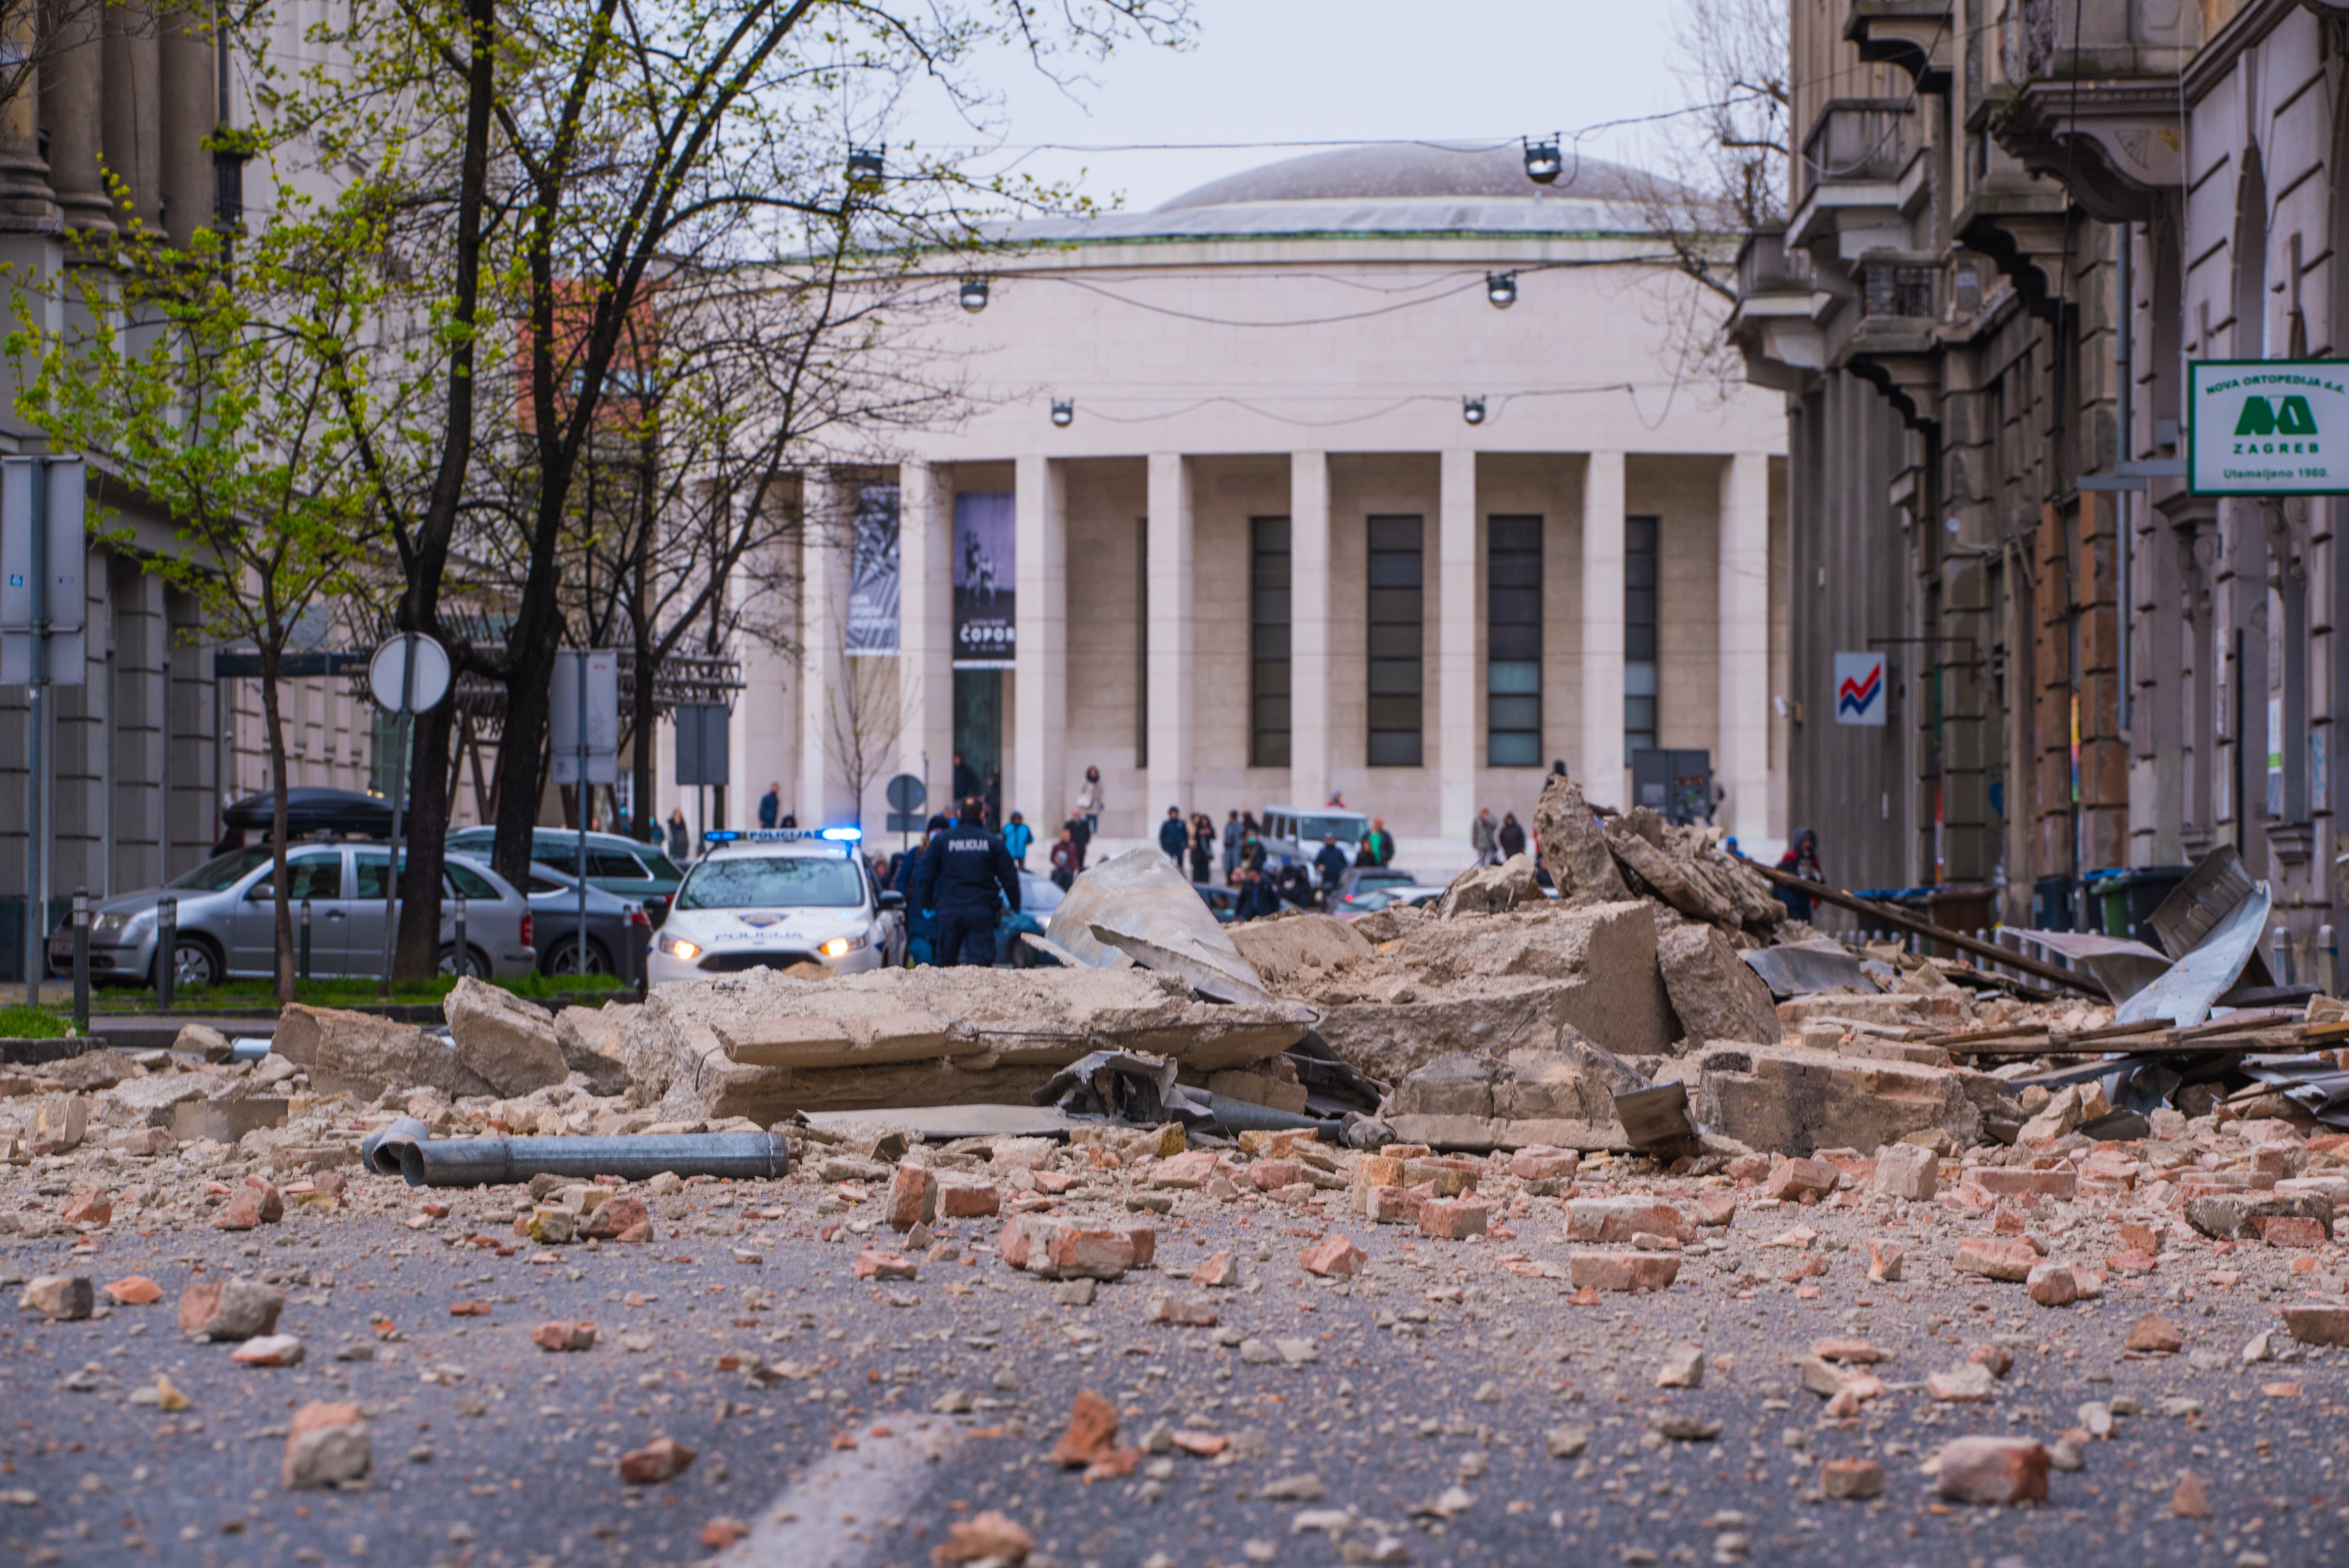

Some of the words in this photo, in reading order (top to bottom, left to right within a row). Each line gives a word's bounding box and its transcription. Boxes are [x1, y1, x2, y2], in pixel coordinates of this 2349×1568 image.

[2206, 378, 2239, 395] NOVA
[2242, 375, 2320, 387] ORTOPEDIJA
[2323, 380, 2345, 394] d.d.
[2233, 442, 2319, 455] ZAGREB
[2223, 468, 2294, 480] Utemeljeno
[749, 829, 813, 840] POLICIJA
[948, 838, 989, 852] POLICIJA
[715, 931, 804, 941] POLICIJA
